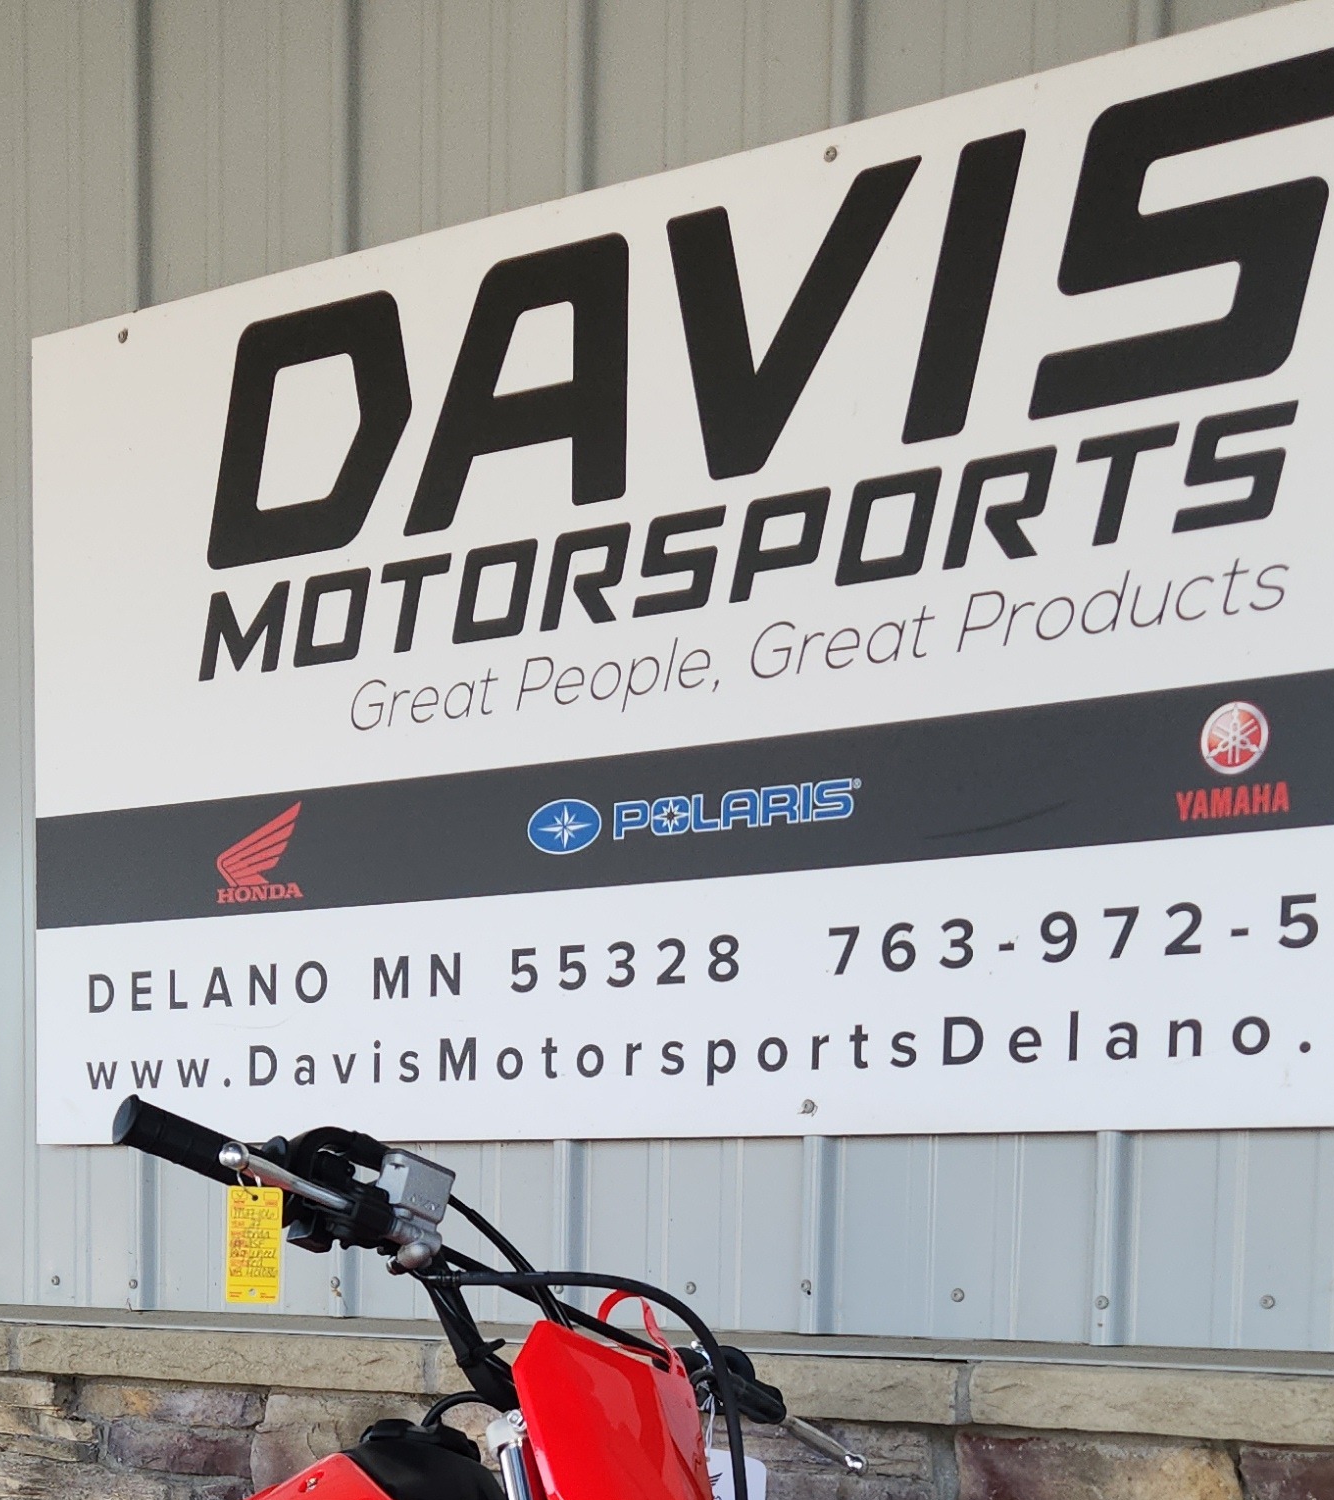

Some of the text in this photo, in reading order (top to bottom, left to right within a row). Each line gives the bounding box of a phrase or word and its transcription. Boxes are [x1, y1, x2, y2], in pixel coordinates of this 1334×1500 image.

[199, 400, 1298, 681] MOTORSPORTS
[350, 557, 1290, 732] Great People, Great Products
[1175, 780, 1290, 822] YAMAHA
[216, 881, 305, 905] HONDA
[90, 961, 327, 1014] DELANO
[374, 953, 461, 999] MN
[511, 935, 738, 992] 55328
